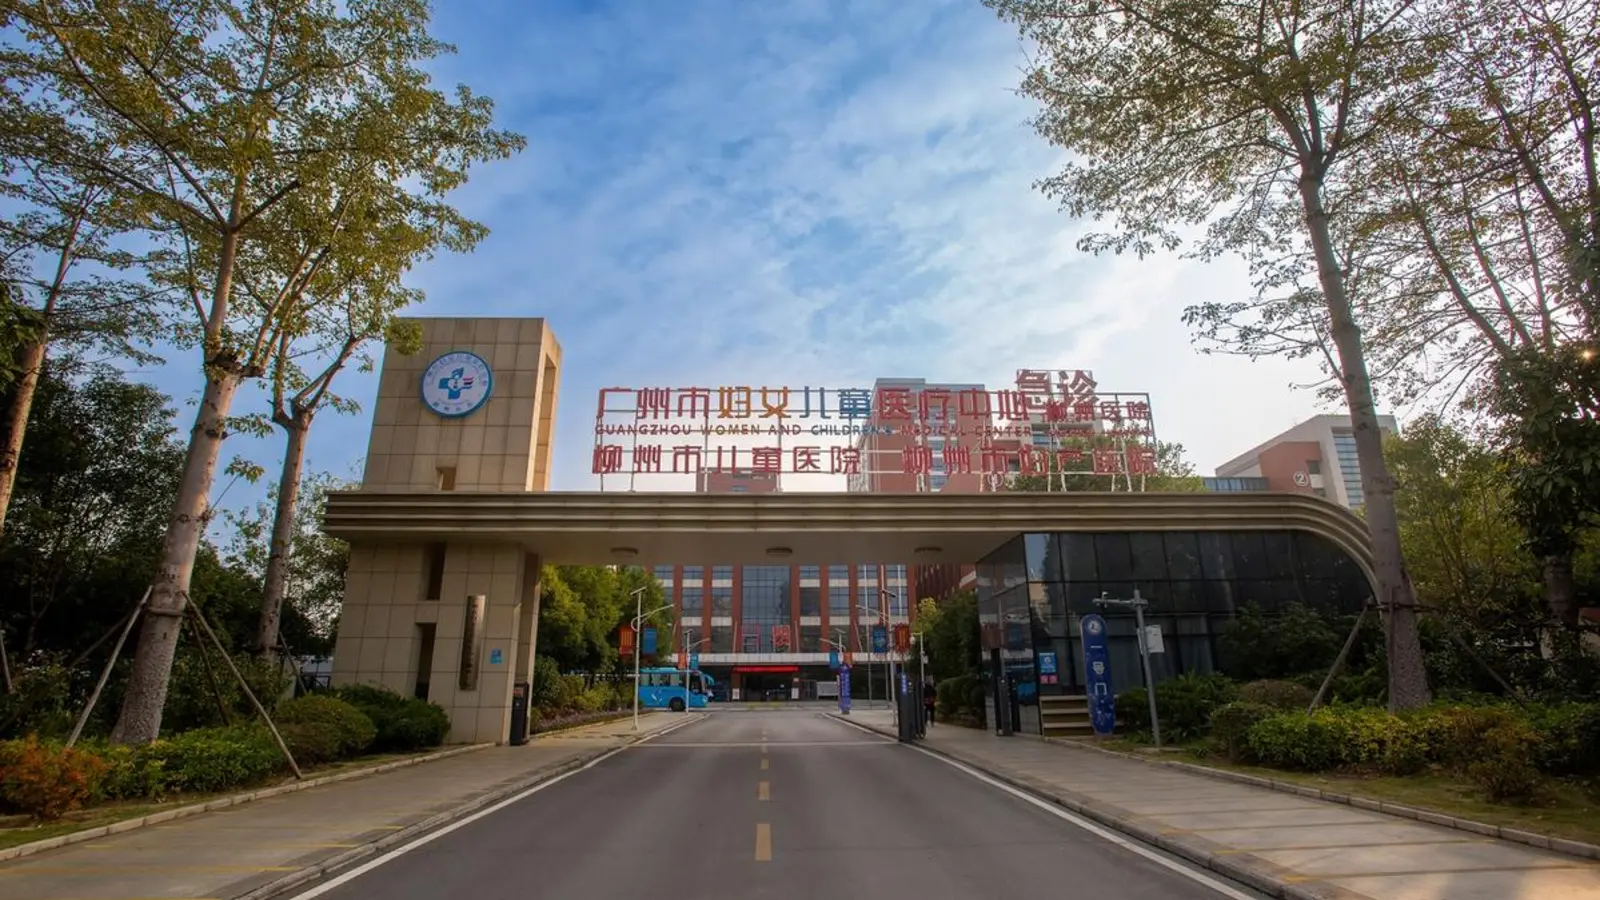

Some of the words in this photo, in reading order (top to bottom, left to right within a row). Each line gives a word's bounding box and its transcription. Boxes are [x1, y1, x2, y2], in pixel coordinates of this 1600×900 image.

[598, 387, 1029, 420] 广州市妇女儿童医疗中心
[1016, 370, 1097, 409] 急诊
[595, 423, 691, 436] GUANGZHOU
[700, 423, 760, 436] WOMEN
[768, 423, 801, 436] AND
[900, 425, 967, 436] MEDICAL
[974, 425, 1032, 437] CENTER
[592, 444, 861, 474] 柳州市儿童医院
